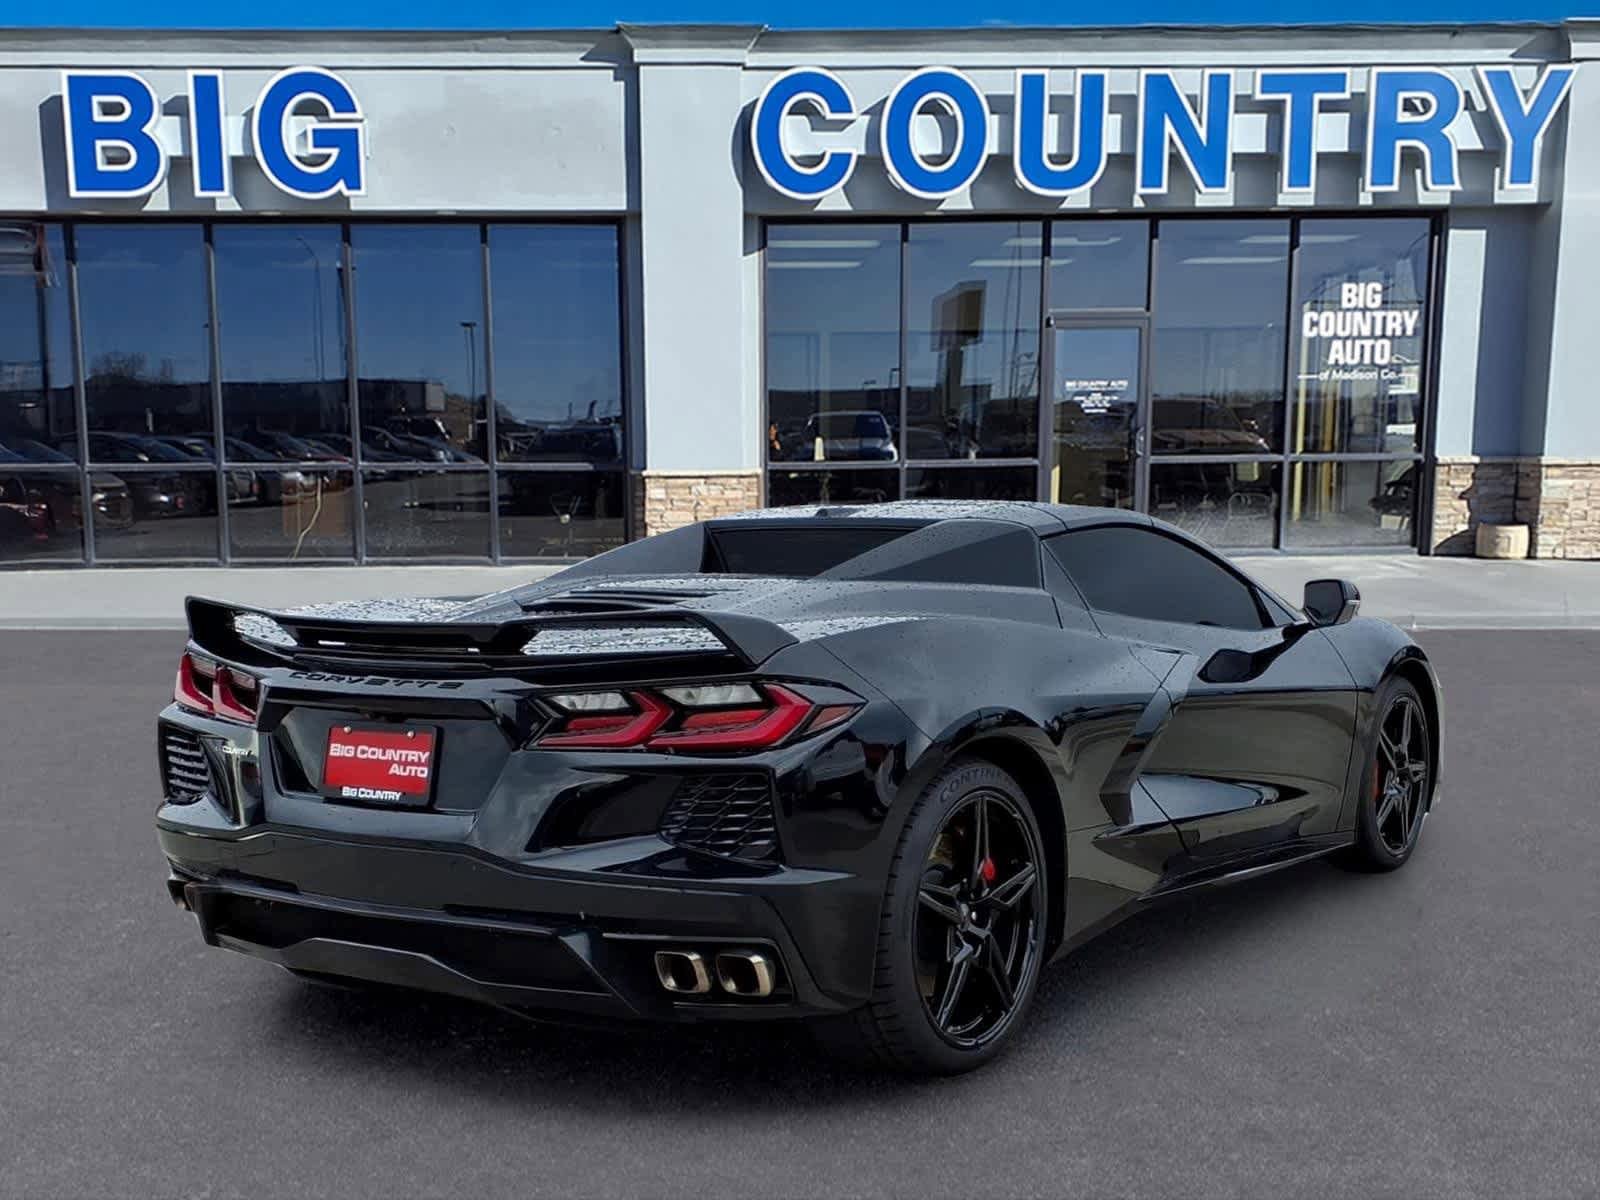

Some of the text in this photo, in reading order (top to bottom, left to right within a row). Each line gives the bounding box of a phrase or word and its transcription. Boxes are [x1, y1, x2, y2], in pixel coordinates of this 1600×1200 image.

[62, 64, 1576, 199] BIG COUNTRY
[1341, 282, 1383, 309] BIG
[1302, 309, 1420, 337] COUNTRY
[1327, 338, 1392, 365] AUTO
[1331, 369, 1378, 380] Madison
[289, 672, 464, 689] CORVETTE
